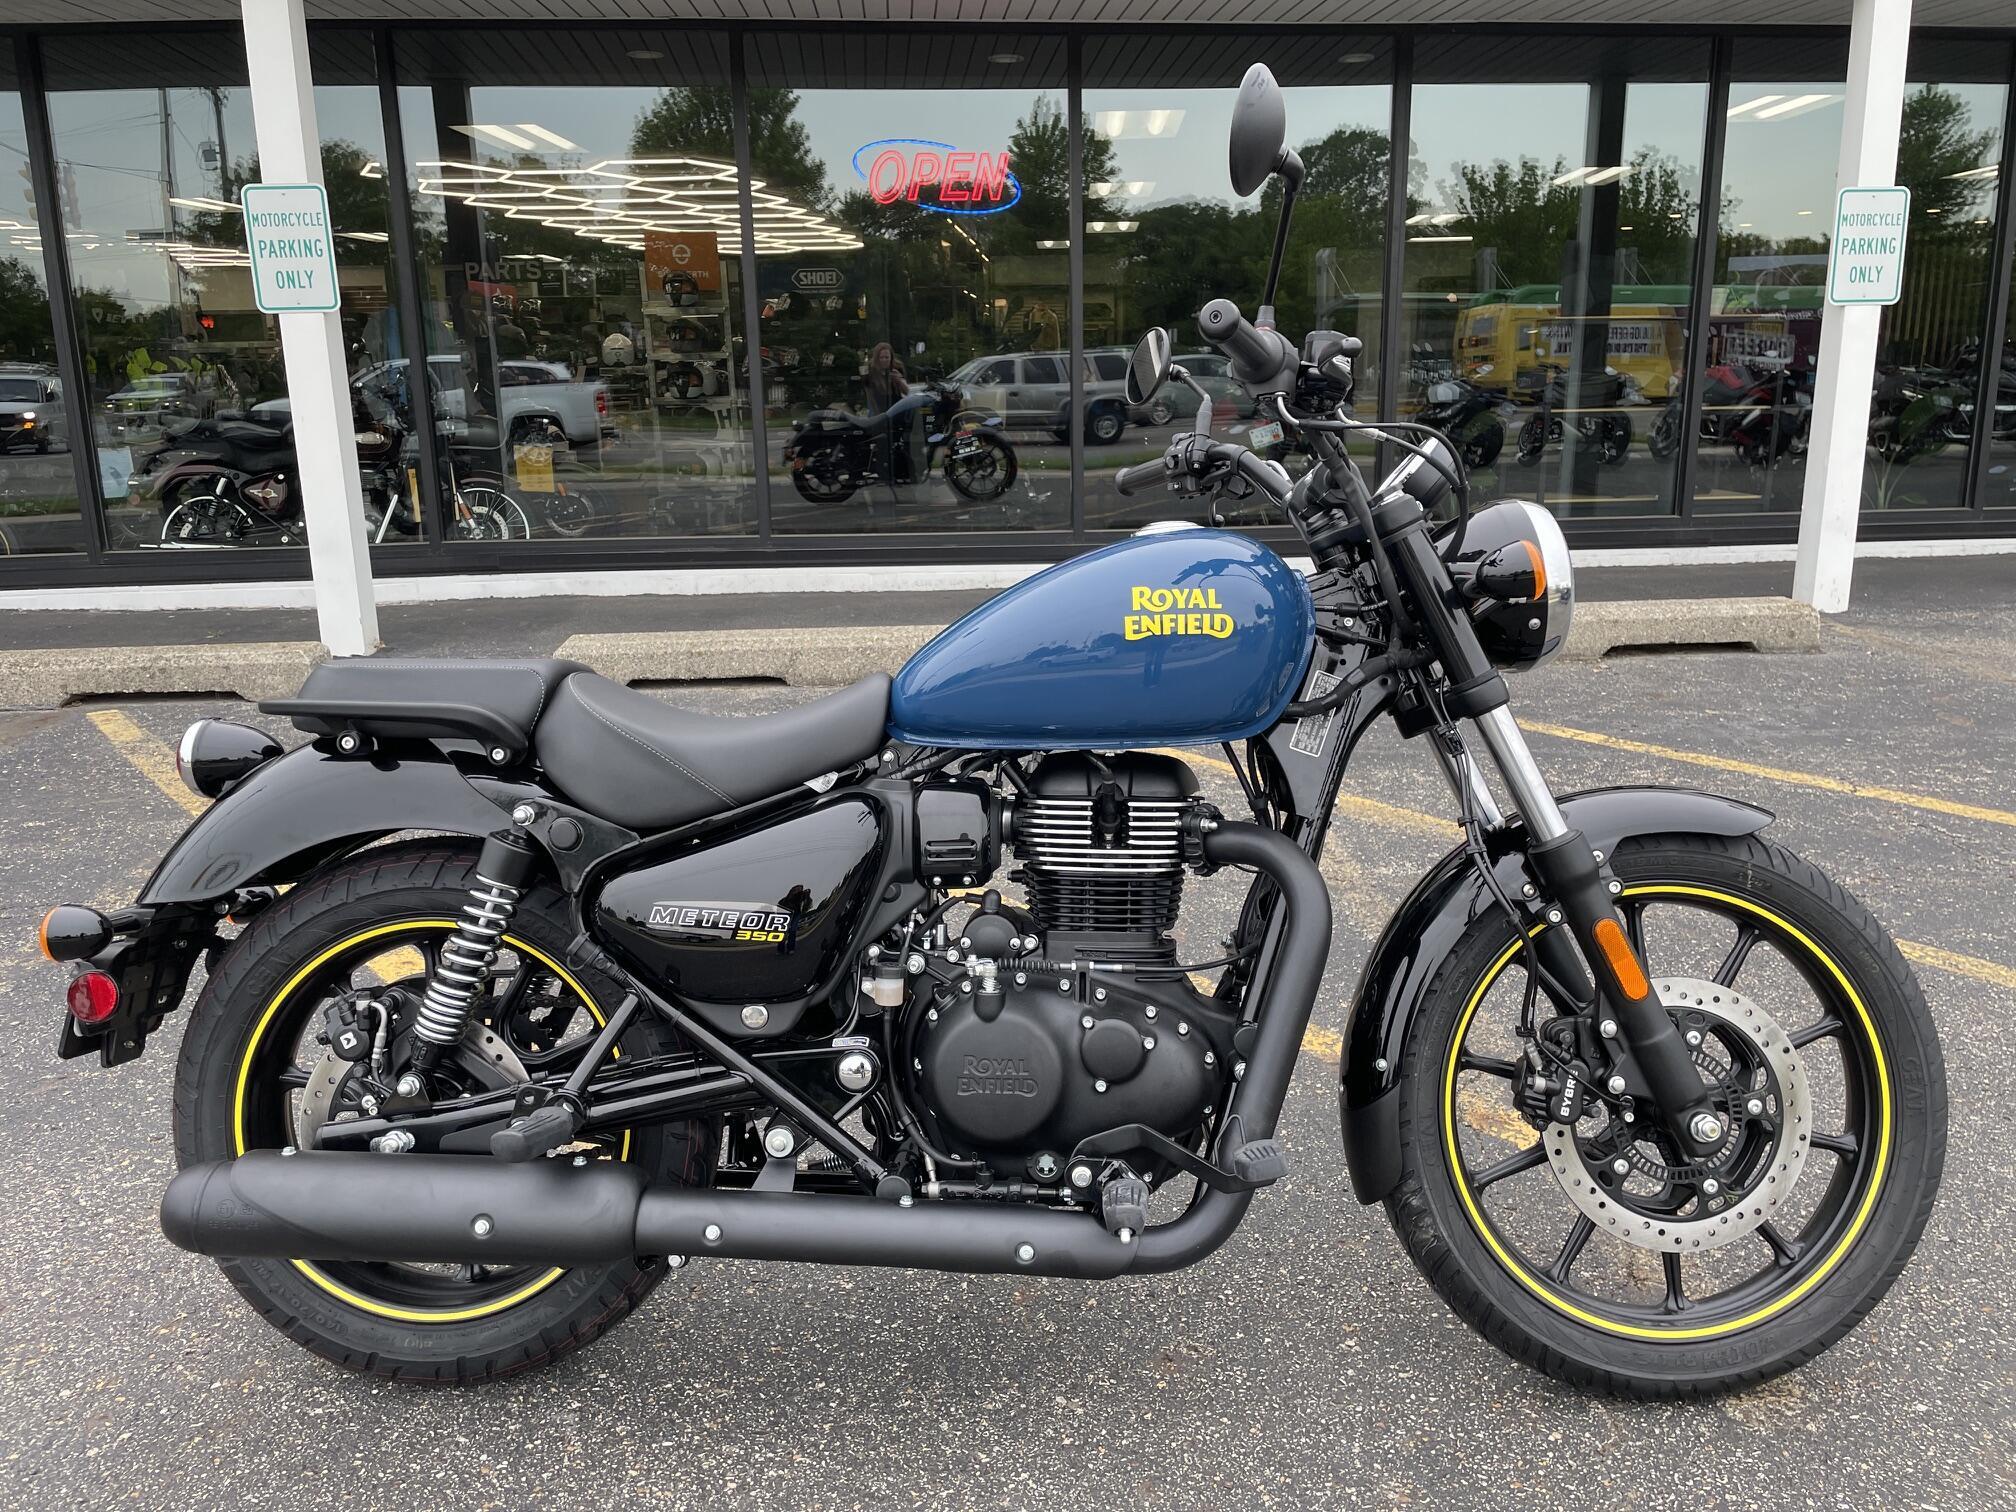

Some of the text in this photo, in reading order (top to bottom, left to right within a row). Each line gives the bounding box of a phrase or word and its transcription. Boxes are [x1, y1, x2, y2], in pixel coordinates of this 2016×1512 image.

[869, 150, 1009, 205] OPEN
[251, 212, 323, 228] MOTORCYCLE
[1841, 213, 1903, 227] MOTORCYCLE
[258, 239, 324, 259] PARKING
[1841, 237, 1897, 256] PARKING
[275, 270, 314, 290] ONLY
[464, 260, 542, 281] PARTS
[798, 271, 838, 285] SHOEI
[1849, 265, 1884, 284] ONLY
[1131, 586, 1223, 613] ROYAL
[1124, 613, 1235, 641] ENFIELD
[648, 905, 791, 932] METEOR
[735, 929, 786, 943] 350
[962, 1054, 1030, 1077] ROYAL
[957, 1076, 1039, 1098] ENFIELD
